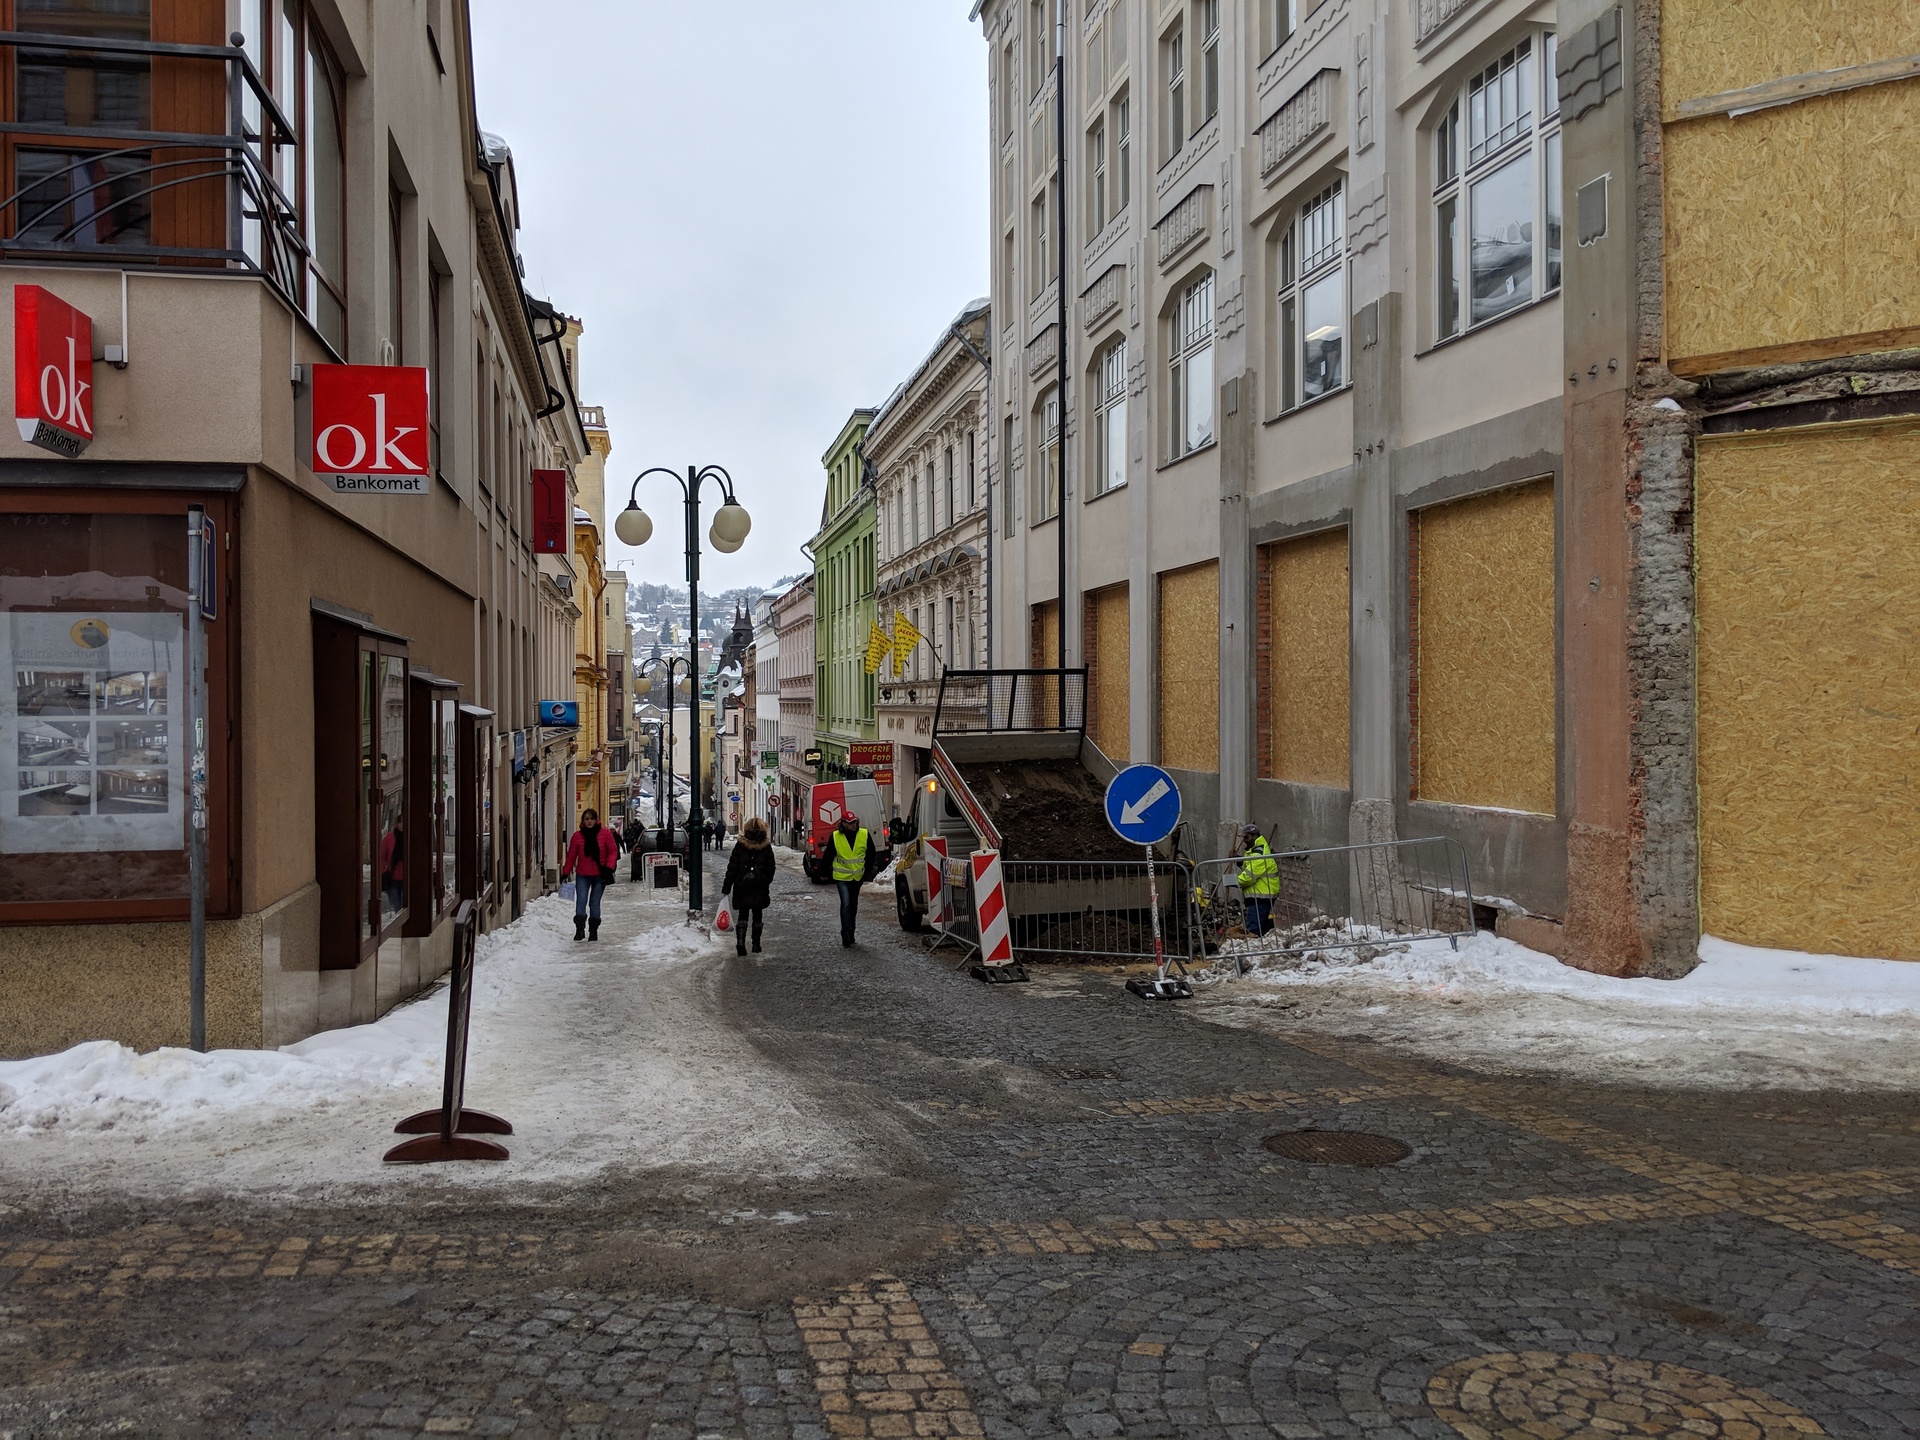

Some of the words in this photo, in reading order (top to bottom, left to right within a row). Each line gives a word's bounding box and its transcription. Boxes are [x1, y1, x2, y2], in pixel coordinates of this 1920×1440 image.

[40, 337, 92, 435] ok
[37, 423, 80, 453] Bankomat
[316, 393, 422, 470] ok
[336, 475, 421, 490] Bankomat
[852, 745, 891, 753] DROGERIE
[871, 754, 891, 762] FOTO
